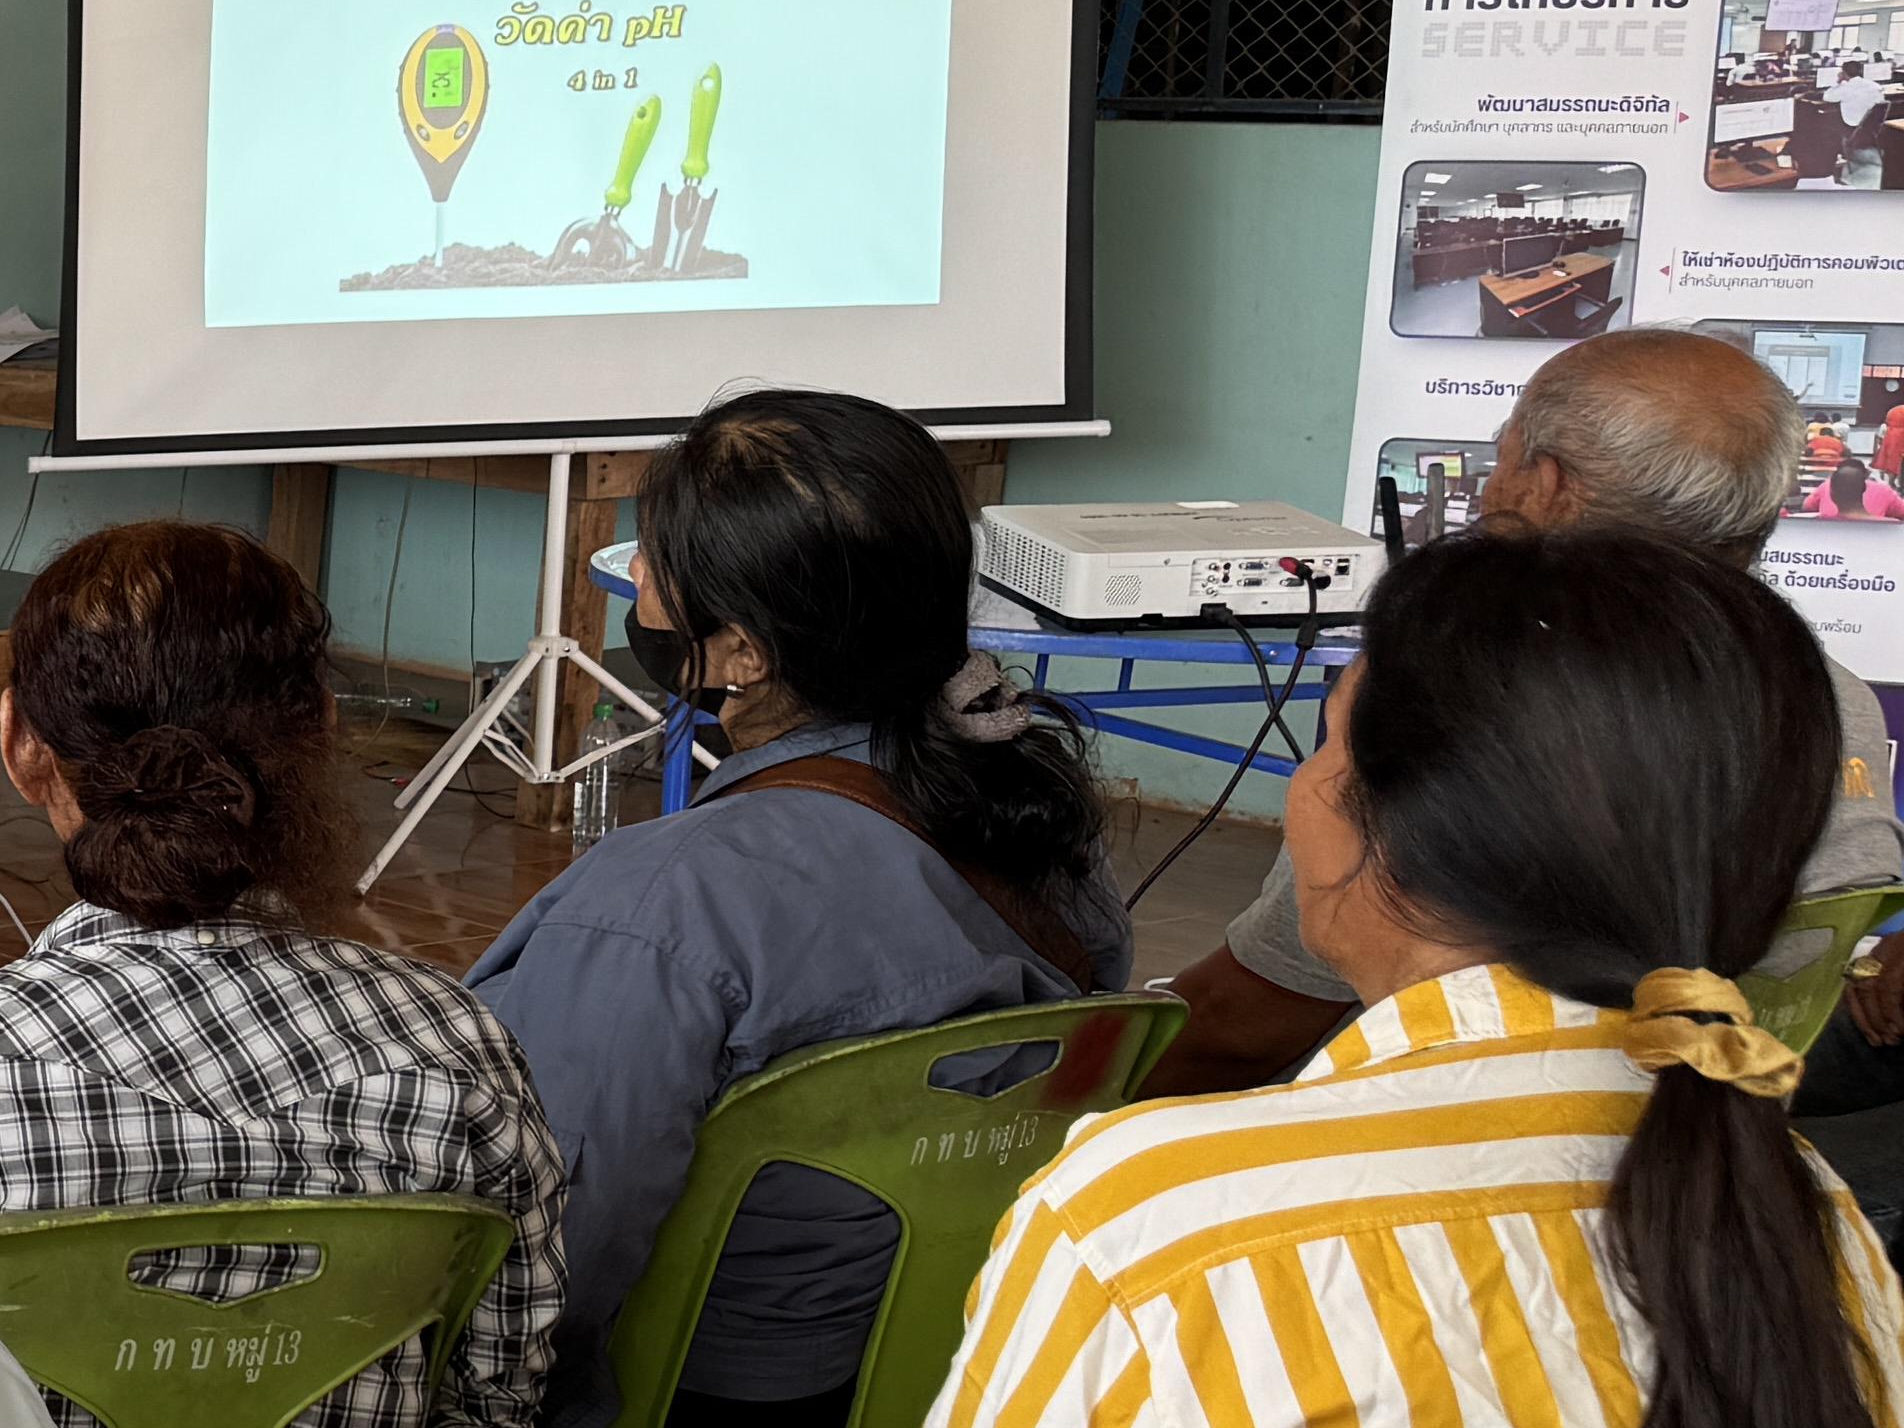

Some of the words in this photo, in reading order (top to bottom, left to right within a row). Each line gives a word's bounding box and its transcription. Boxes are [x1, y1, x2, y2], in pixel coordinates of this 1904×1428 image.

[495, 0, 613, 45] วัดค่า
[622, 4, 686, 49] pH
[1421, 18, 1687, 58] SERVICE
[567, 70, 586, 91] 4
[592, 70, 615, 90] in
[624, 67, 638, 89] 1
[1478, 93, 1671, 114] พัฒนาสมรรถนะดิจิทัล
[1682, 250, 1904, 274] ให้เช่าห้องปฏิบัติการคอมพิวเต
[1785, 569, 1896, 593] ด้วยเครื่องมือ
